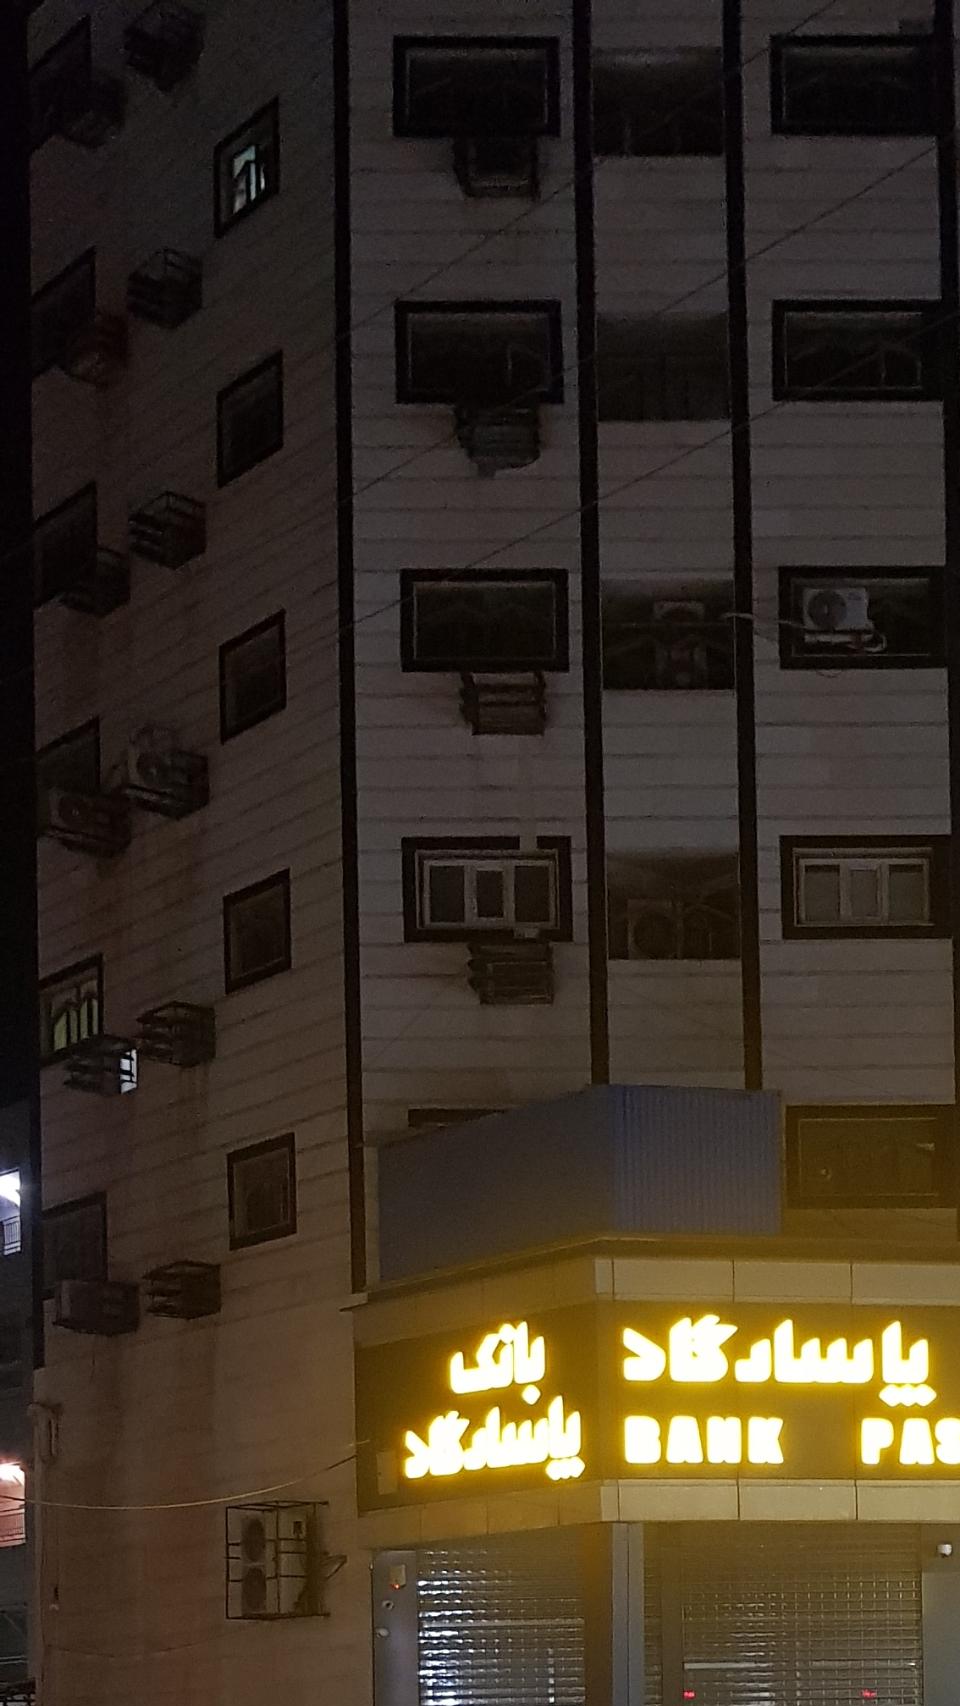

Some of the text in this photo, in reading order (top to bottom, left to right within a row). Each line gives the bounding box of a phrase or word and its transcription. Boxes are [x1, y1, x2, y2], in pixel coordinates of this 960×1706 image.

[449, 1321, 546, 1405] بانک
[622, 1314, 937, 1407] پاسارگاد
[405, 1395, 586, 1481] پاسارگاد
[623, 1415, 784, 1464] BANK
